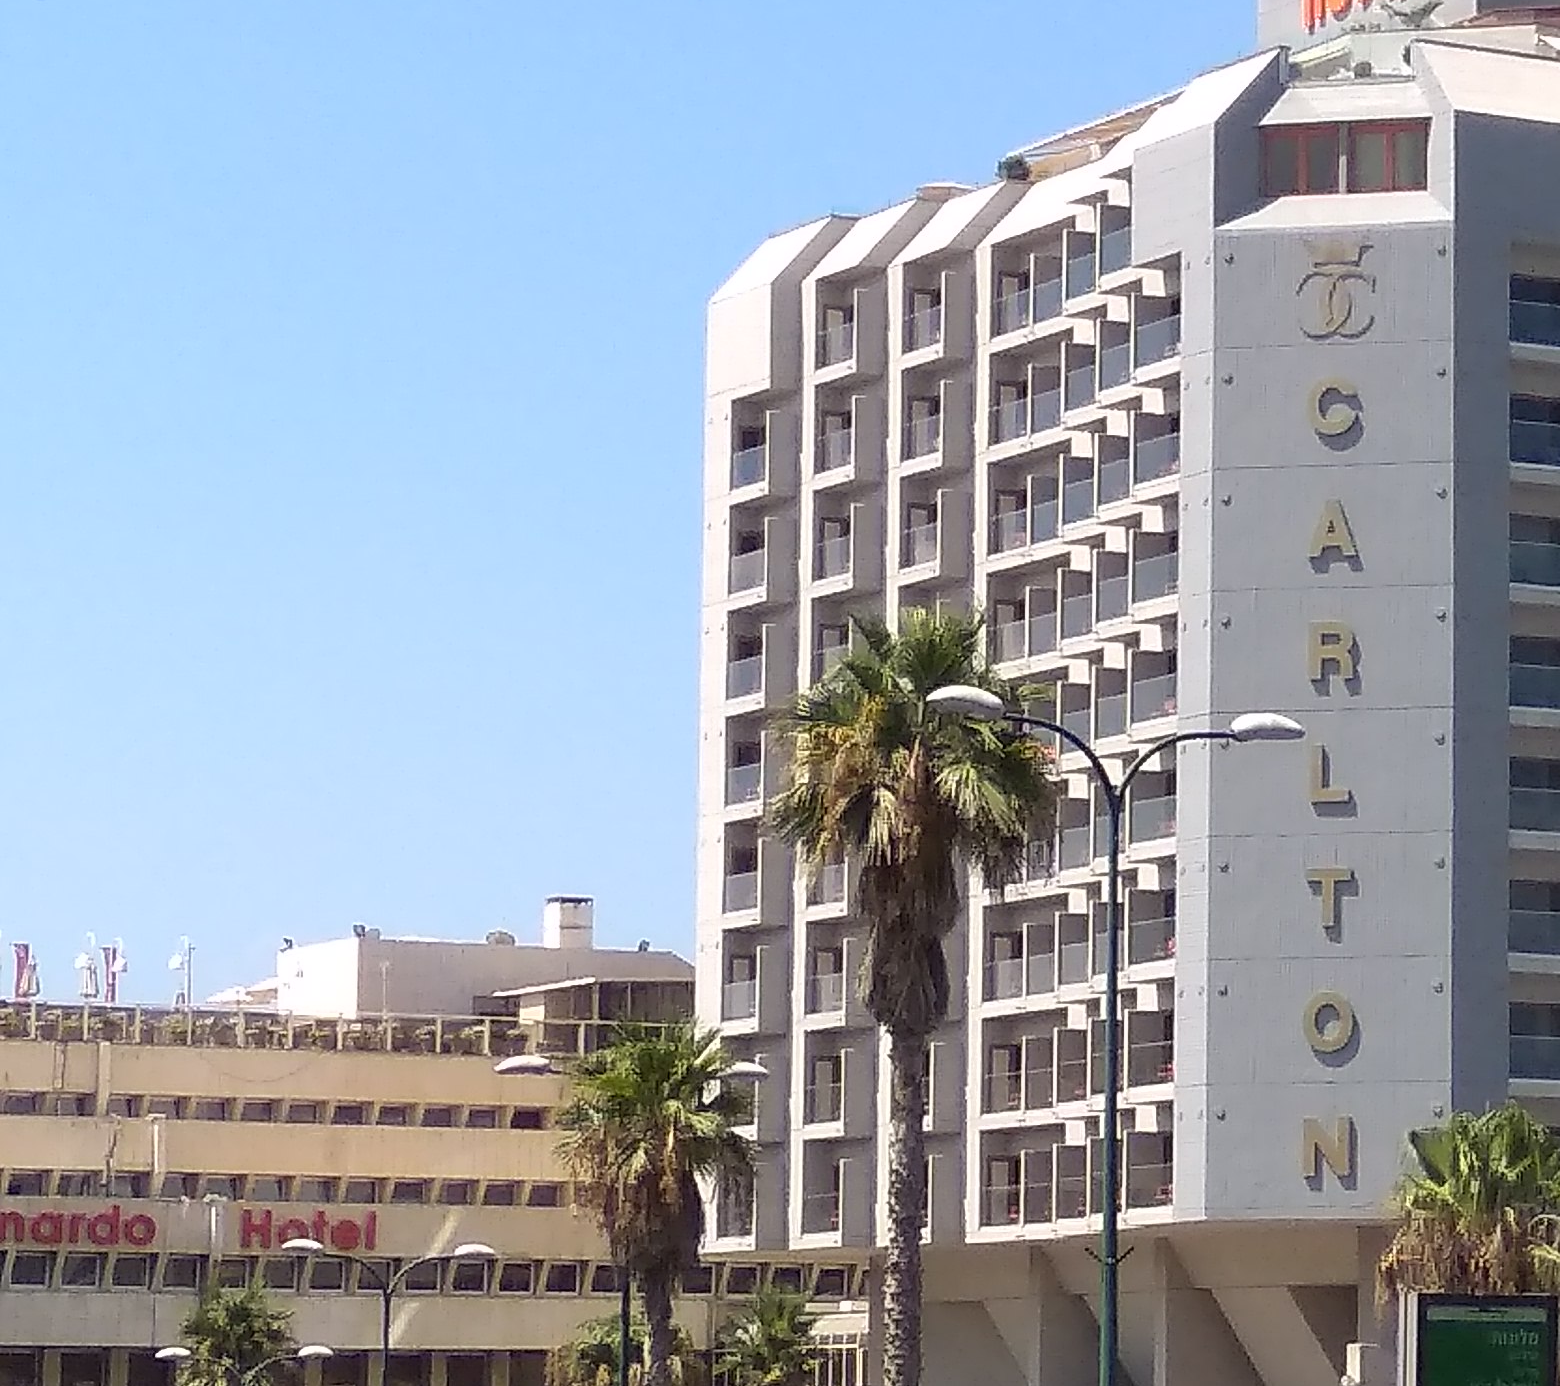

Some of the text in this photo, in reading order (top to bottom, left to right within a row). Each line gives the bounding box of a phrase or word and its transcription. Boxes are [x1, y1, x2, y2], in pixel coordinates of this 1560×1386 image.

[1302, 377, 1364, 1189] CARLTON
[0, 1204, 377, 1250] nardo Hotel
